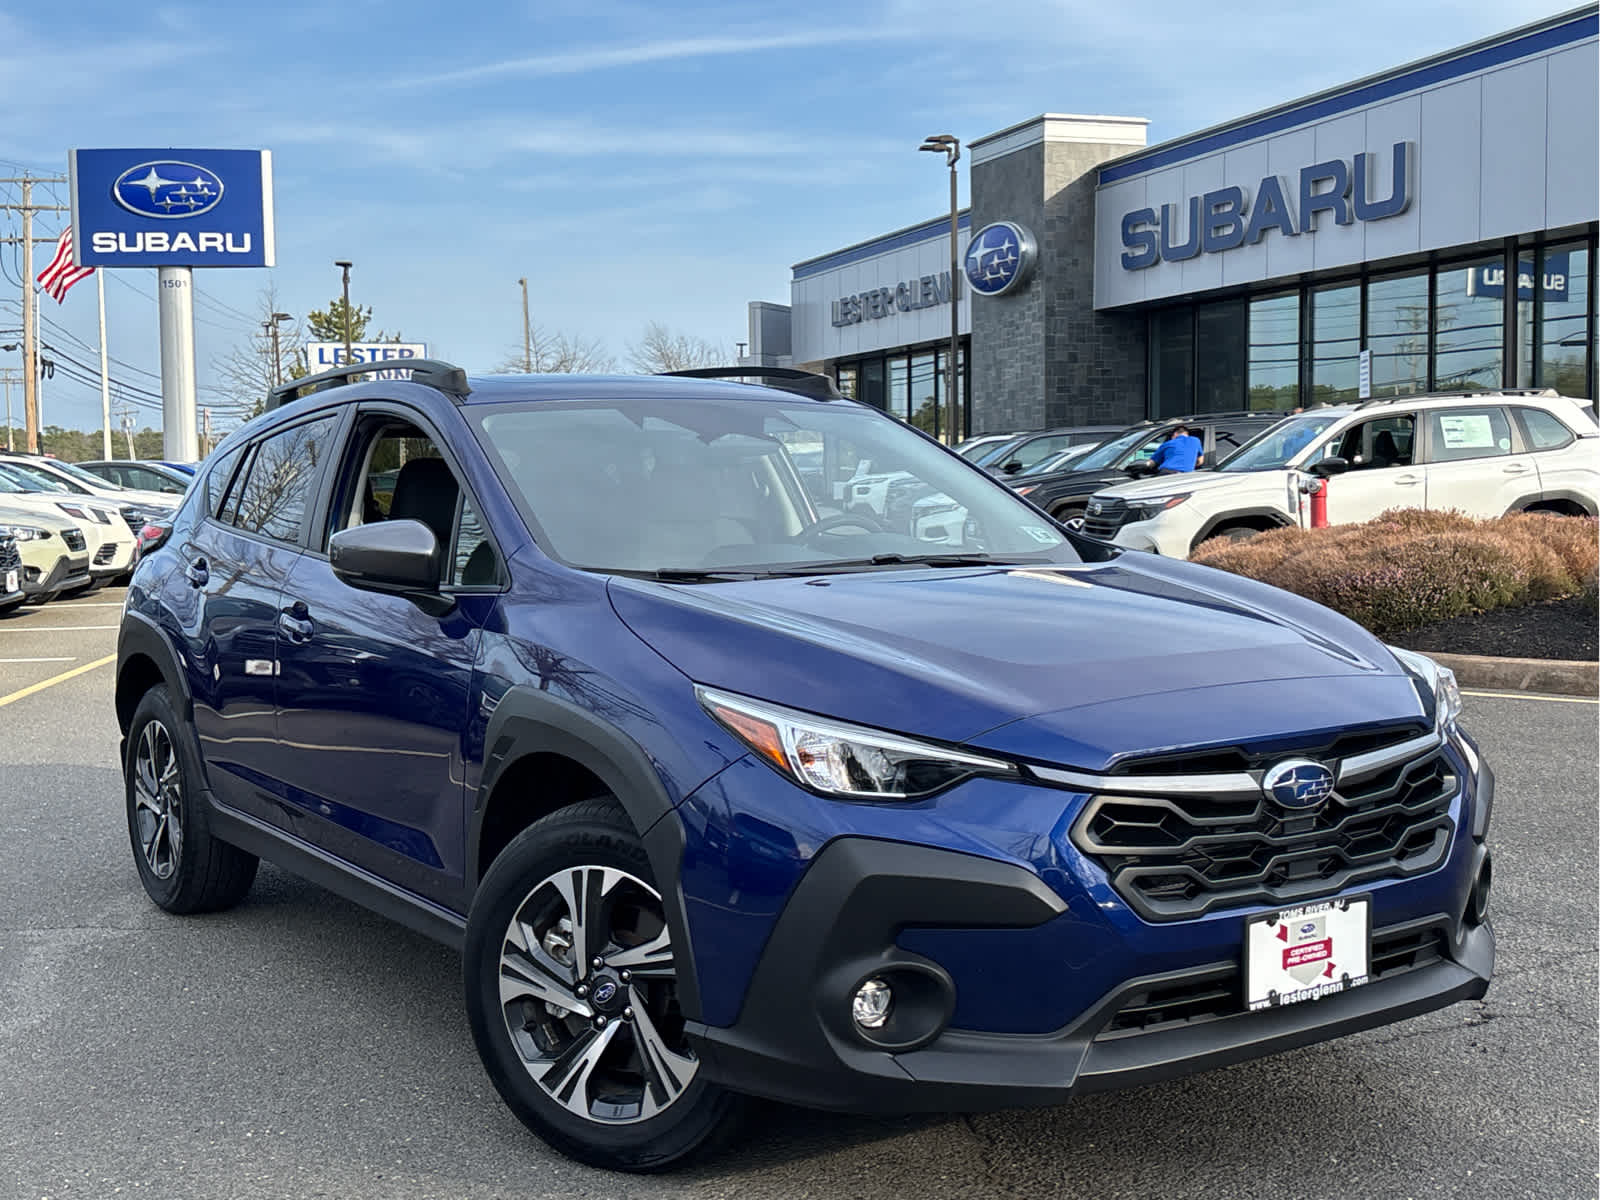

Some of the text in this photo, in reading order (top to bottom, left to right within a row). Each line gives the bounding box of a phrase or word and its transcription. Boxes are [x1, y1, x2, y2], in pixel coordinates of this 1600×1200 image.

[1121, 141, 1415, 272] SUBARU
[92, 232, 252, 253] SUBARU
[162, 279, 187, 289] 1501
[831, 286, 896, 329] LESTER
[318, 347, 415, 365] LESTER
[1279, 907, 1304, 919] TOMS
[1334, 898, 1346, 909] NJ
[1286, 950, 1327, 965] PRE-OWNED
[1290, 944, 1324, 957] CERTIFIED
